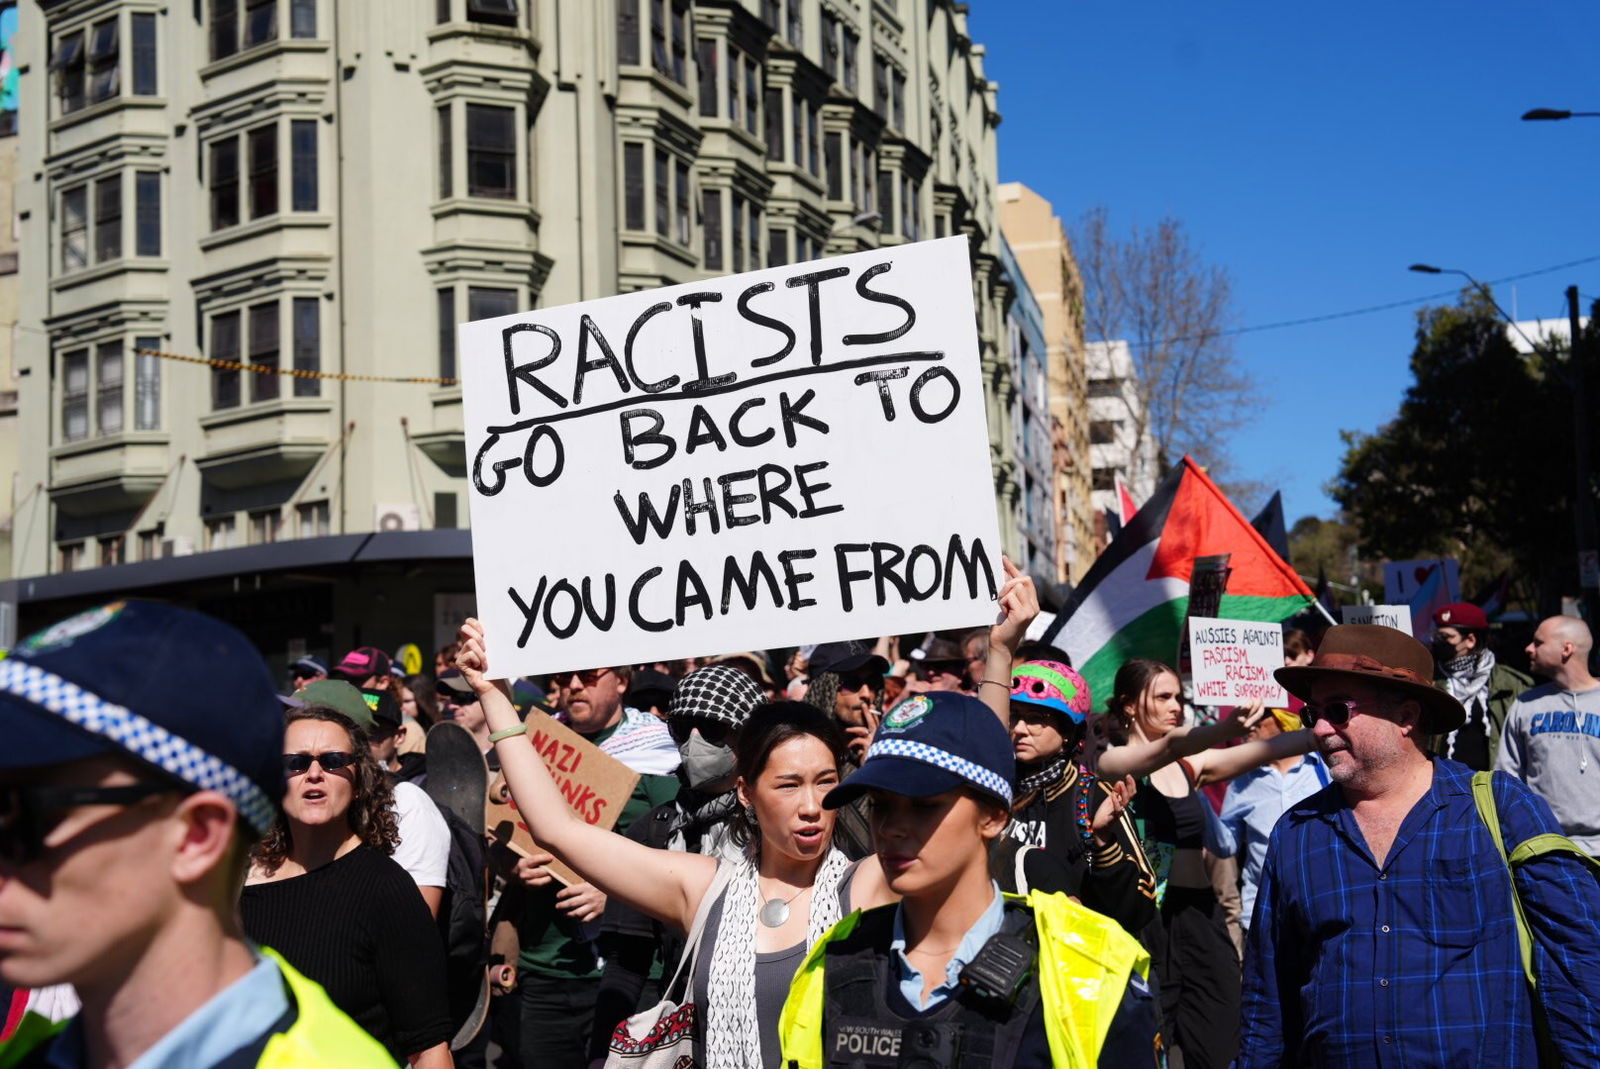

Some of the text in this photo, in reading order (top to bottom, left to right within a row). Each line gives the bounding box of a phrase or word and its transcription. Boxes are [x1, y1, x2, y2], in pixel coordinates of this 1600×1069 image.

[502, 263, 917, 415] RACISTS
[472, 366, 961, 497] GO BACK TO
[613, 460, 844, 545] WHERE
[507, 533, 998, 649] YOU CAME FROM
[1195, 627, 1281, 647] AUSSIES AGAINST
[1196, 681, 1283, 700] WHITE SUPREMACY
[531, 729, 582, 774] NAZI
[836, 1033, 903, 1057] POLICE
